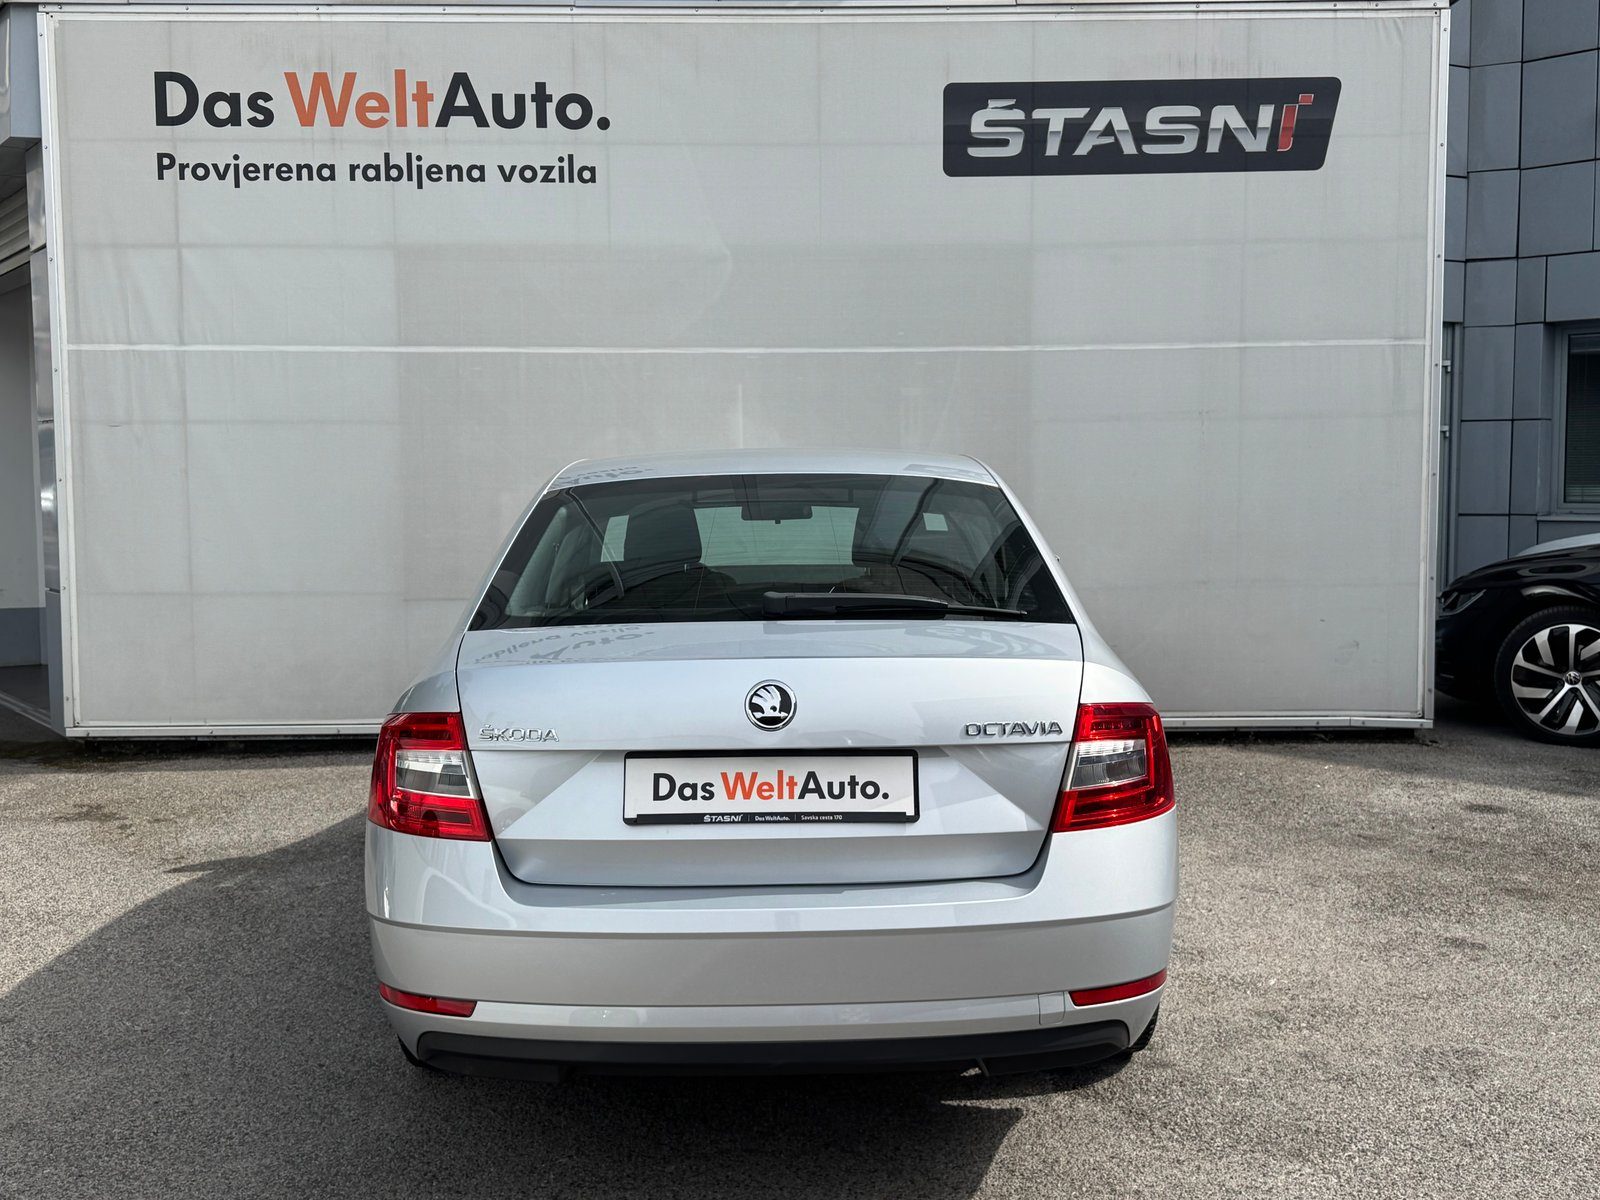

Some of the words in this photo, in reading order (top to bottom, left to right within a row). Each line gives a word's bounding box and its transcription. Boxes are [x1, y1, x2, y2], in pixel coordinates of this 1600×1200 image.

[154, 71, 275, 128] Das
[284, 68, 611, 131] WeltAuto.
[156, 151, 336, 189] Provjerena
[349, 152, 486, 190] rabljena
[497, 153, 597, 184] vozila
[479, 724, 560, 743] ŠKODA
[964, 721, 1063, 738] OCTAVIA
[652, 772, 715, 802] Das
[720, 769, 890, 801] WeltAuto.
